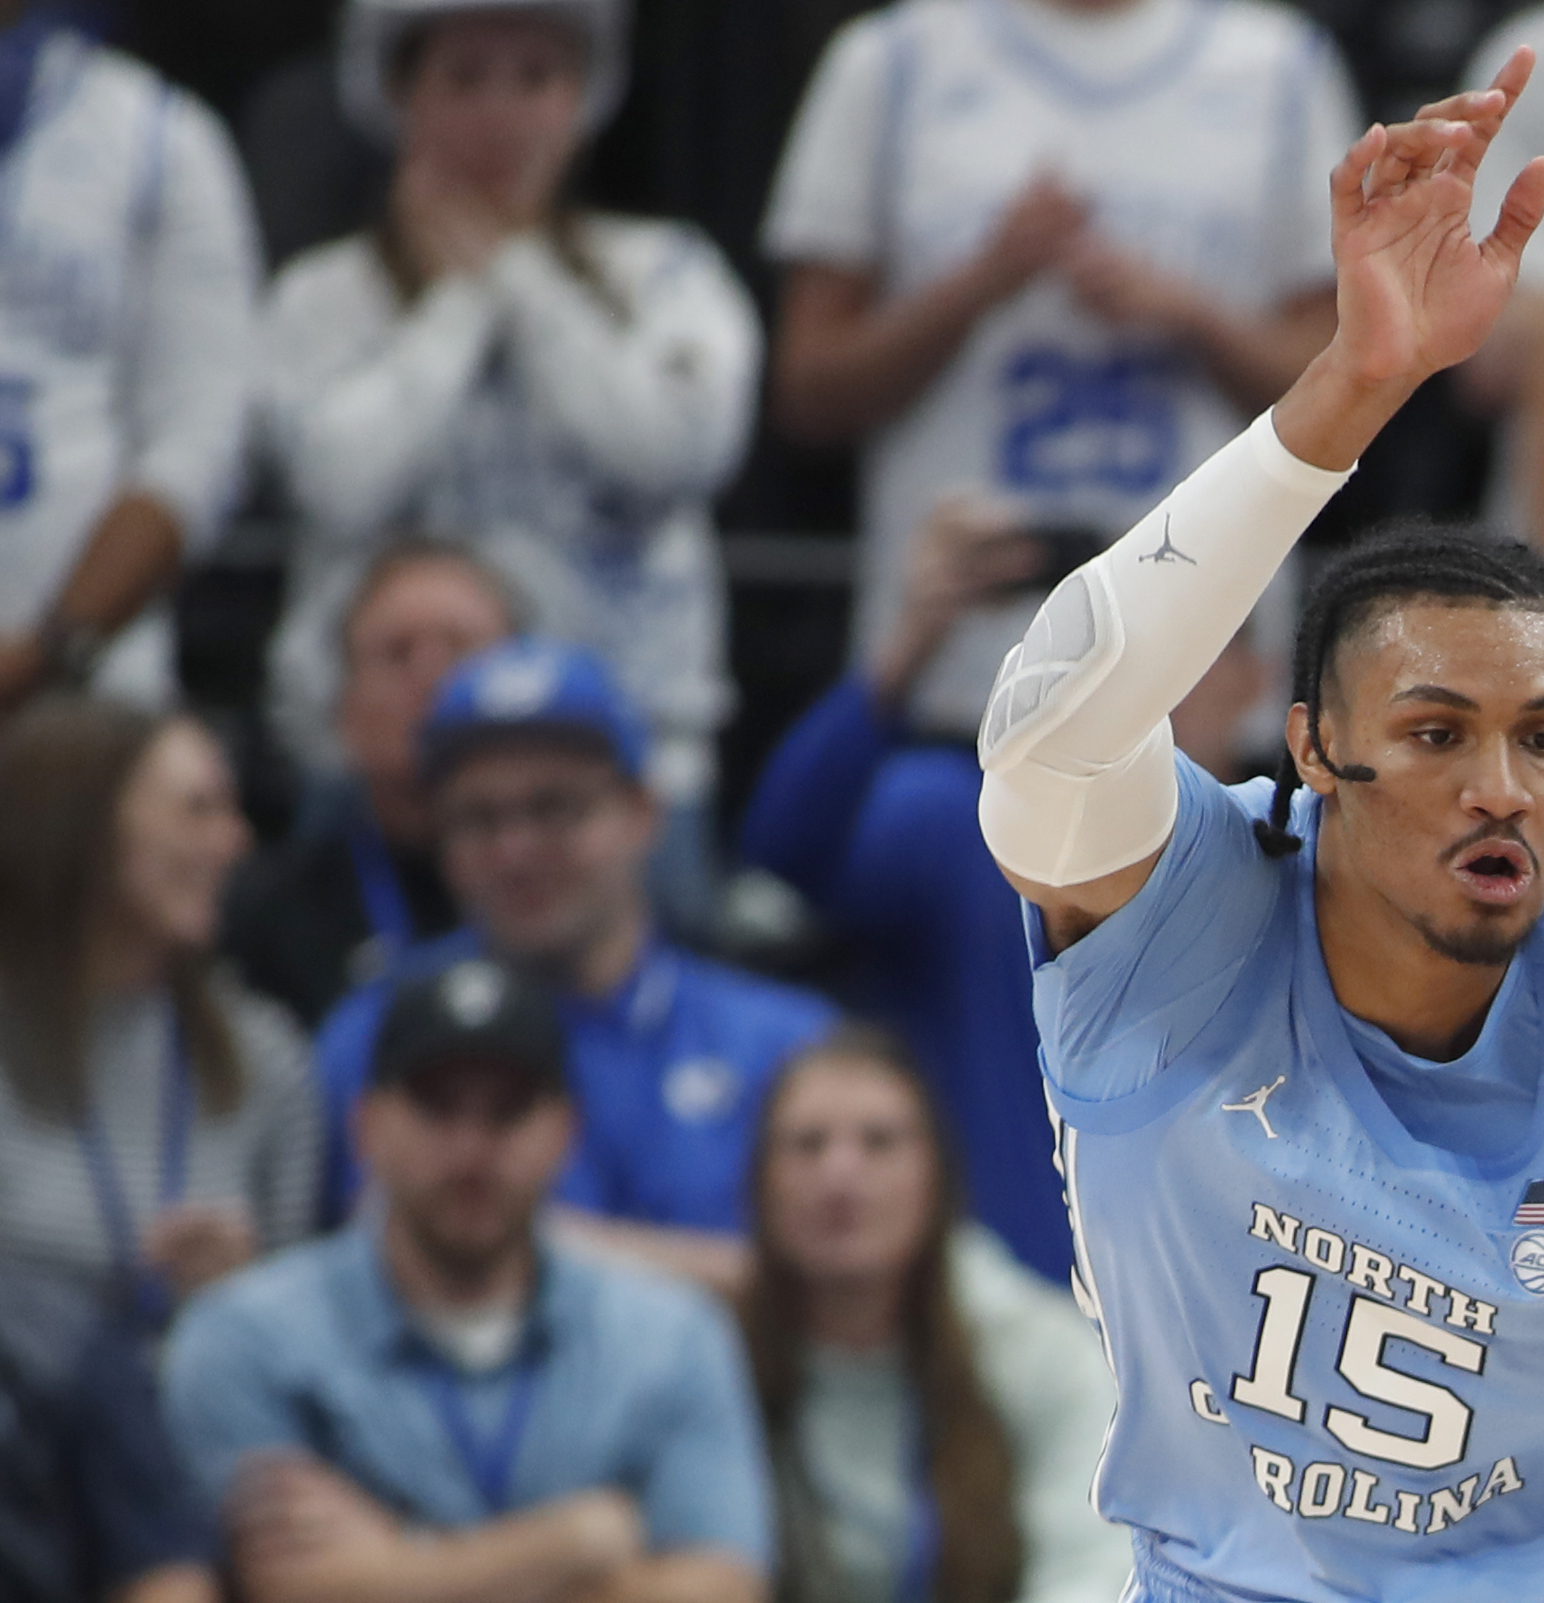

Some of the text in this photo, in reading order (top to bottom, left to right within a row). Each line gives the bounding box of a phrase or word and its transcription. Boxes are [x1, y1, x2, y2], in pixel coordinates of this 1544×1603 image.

[1248, 1201, 1498, 1334] NORTH
[1229, 1264, 1486, 1470] 15
[1189, 1378, 1524, 1536] CROLINA
